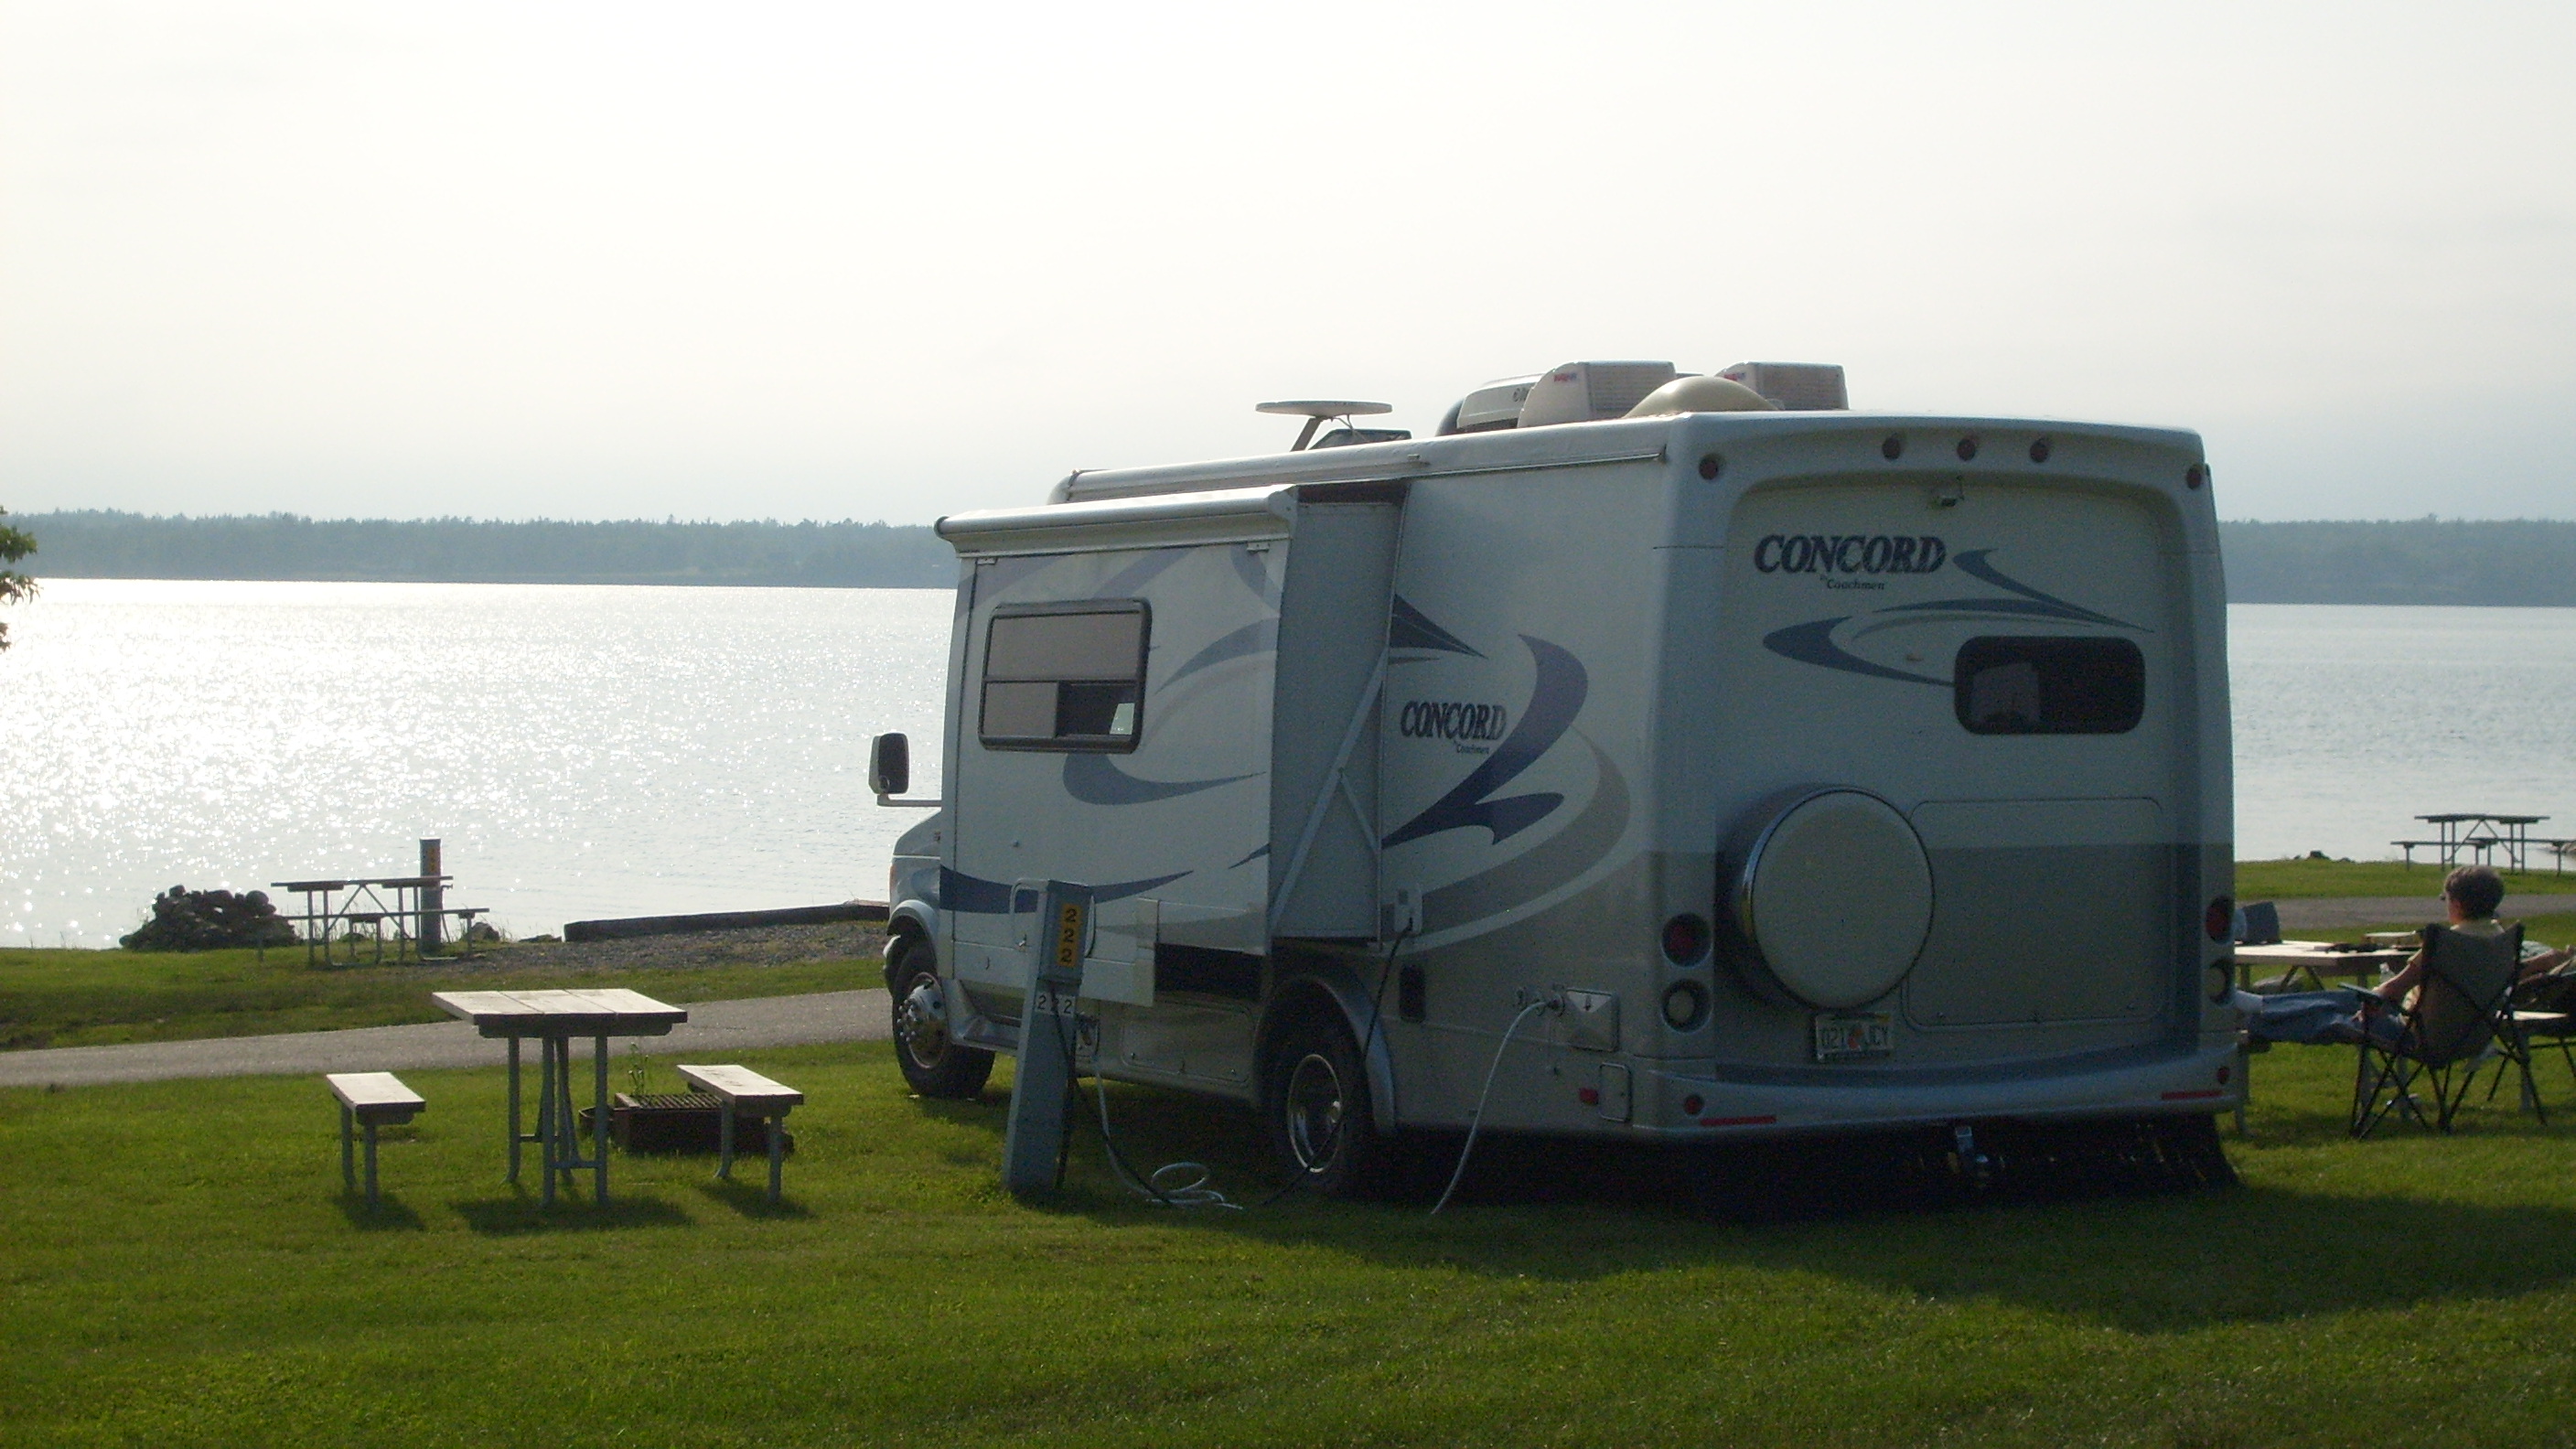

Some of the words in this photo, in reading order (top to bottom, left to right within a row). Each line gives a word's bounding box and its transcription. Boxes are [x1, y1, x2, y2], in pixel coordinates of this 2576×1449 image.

[1755, 534, 1947, 574] CONCORD
[1827, 578, 1885, 590] Coachmen
[1401, 701, 1507, 740] CONCORD
